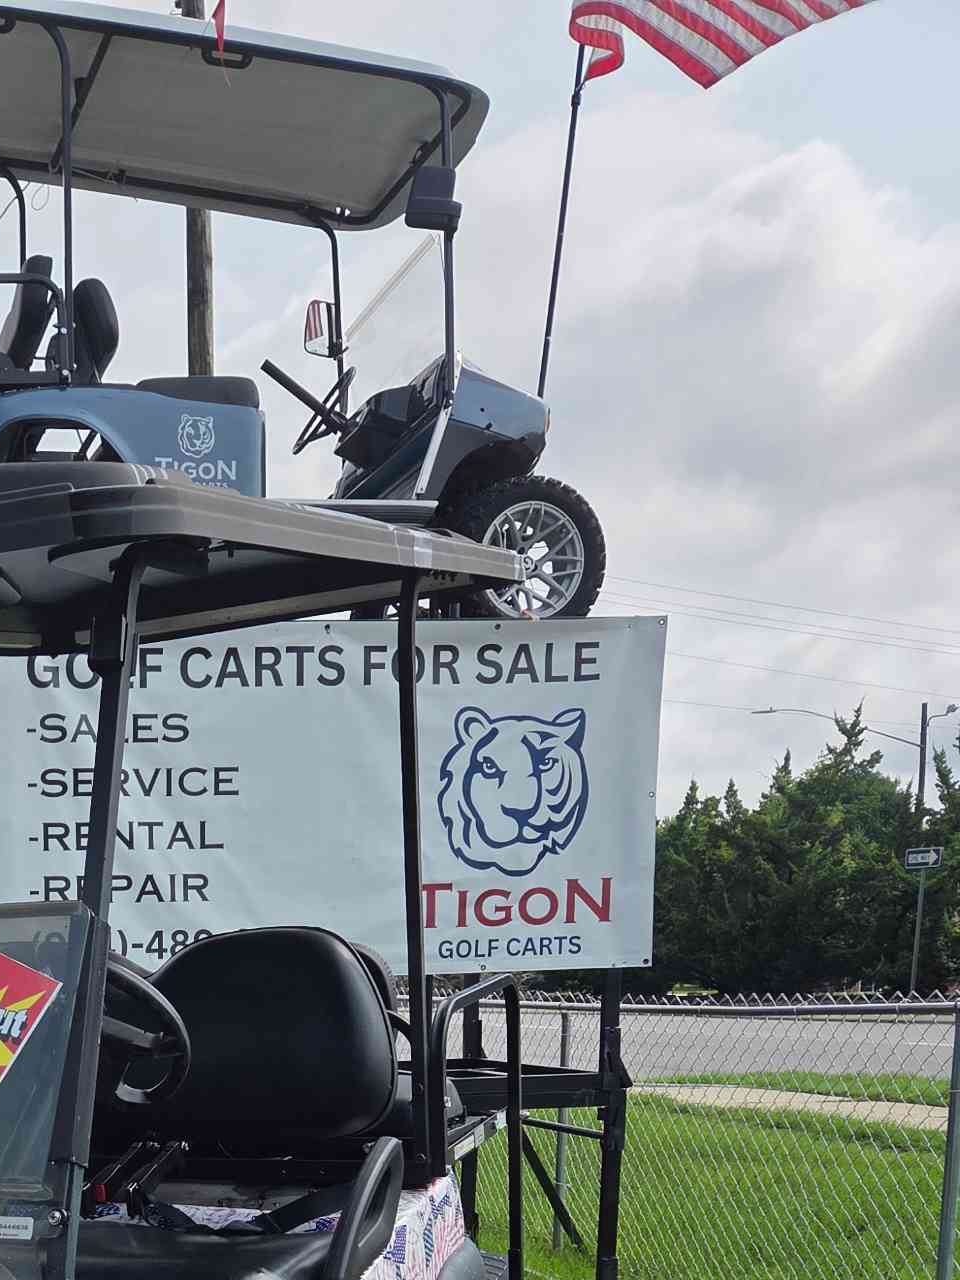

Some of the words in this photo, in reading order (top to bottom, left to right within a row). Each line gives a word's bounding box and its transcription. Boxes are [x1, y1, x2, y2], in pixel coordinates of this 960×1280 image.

[27, 647, 164, 689] GOF
[180, 645, 346, 689] CARTS
[363, 644, 461, 687] FOR
[475, 641, 601, 685] SALE
[26, 712, 190, 743] -SAES
[421, 877, 613, 929] TIGON
[438, 938, 500, 959] GOLF
[506, 935, 582, 956] CARTS
